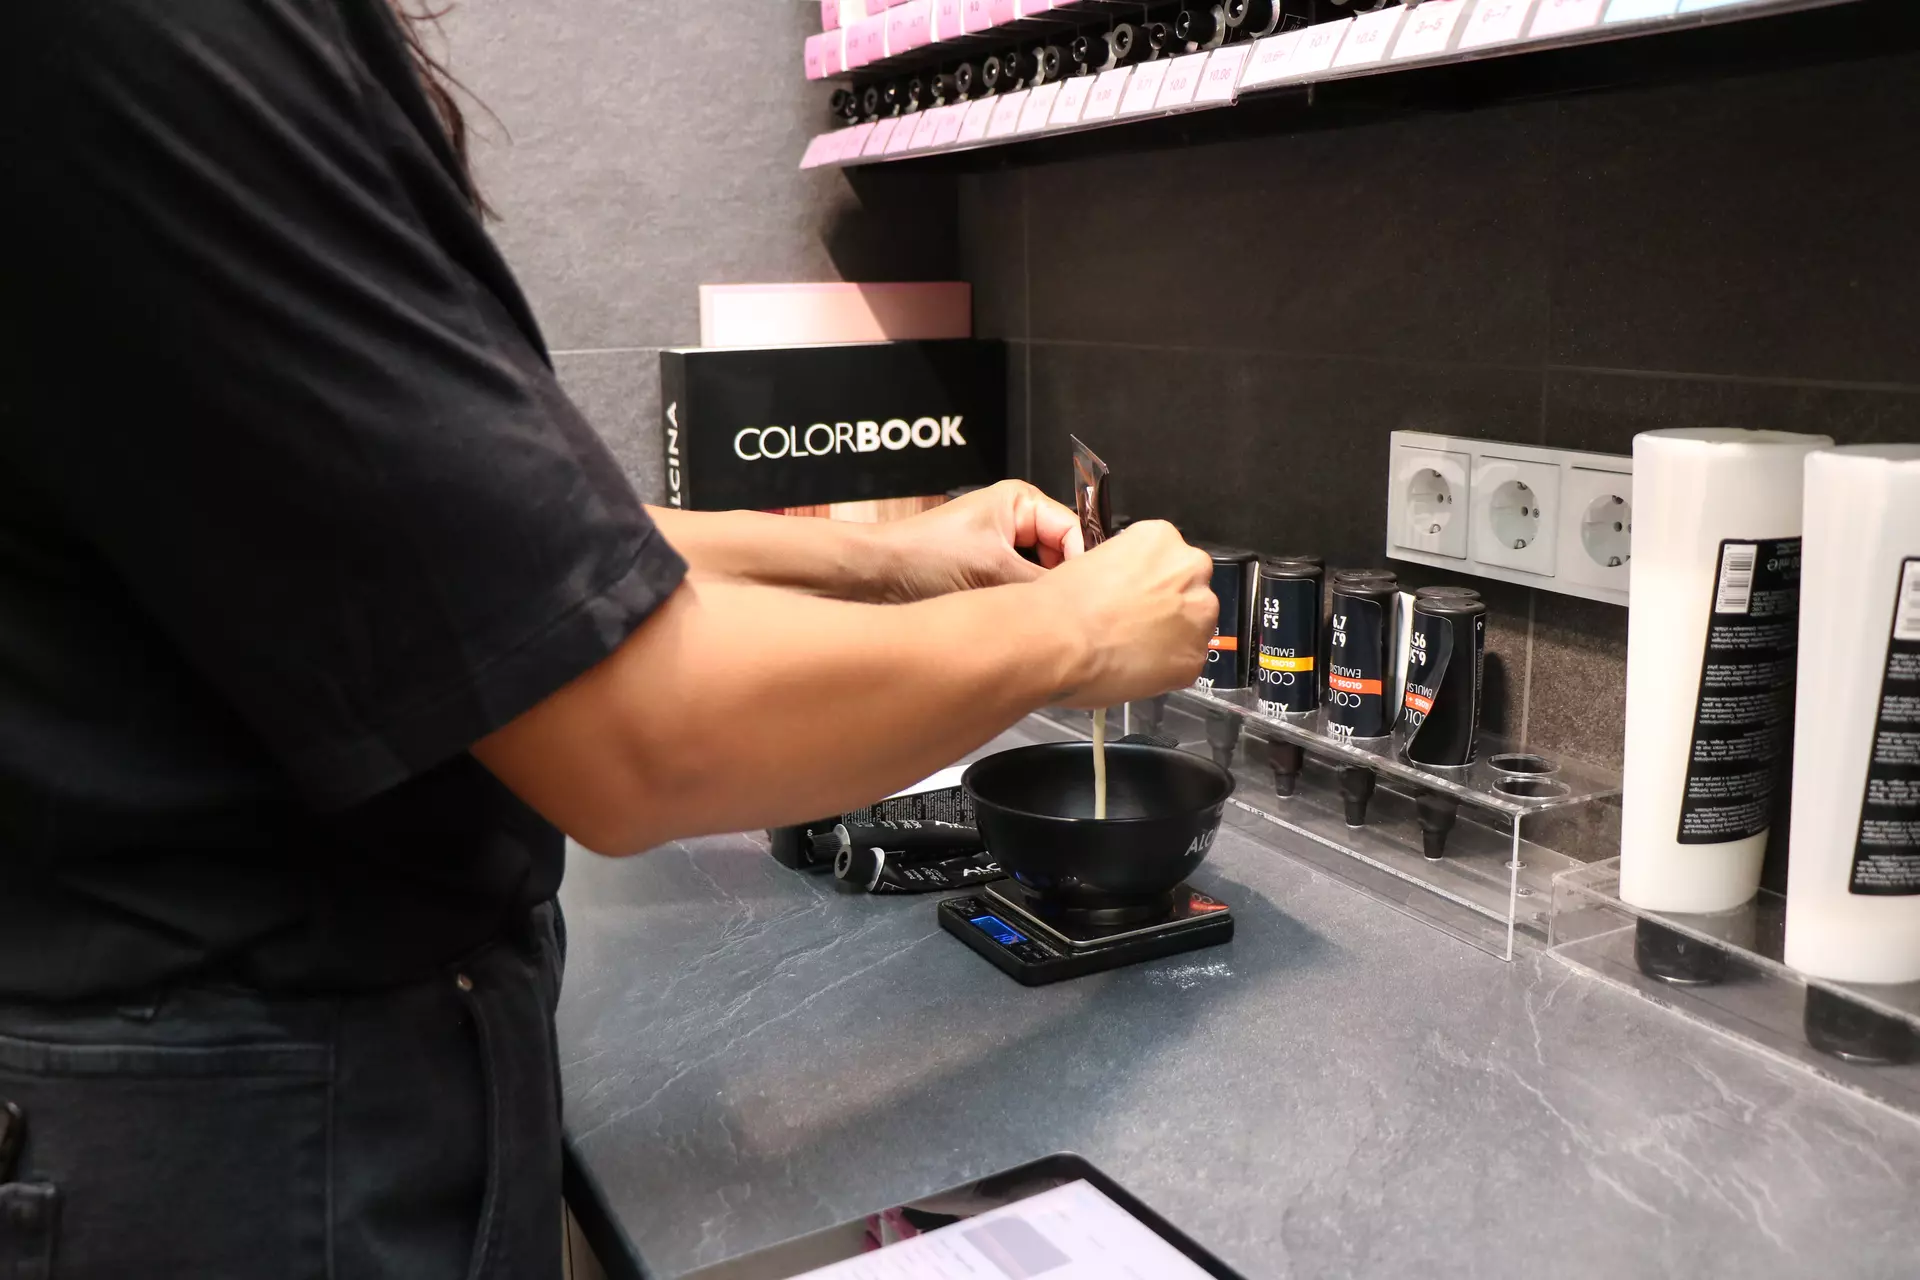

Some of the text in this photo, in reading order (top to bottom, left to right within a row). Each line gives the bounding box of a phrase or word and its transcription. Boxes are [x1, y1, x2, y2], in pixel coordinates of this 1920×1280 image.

[734, 415, 966, 461] COLORBOOK
[667, 402, 681, 509] LCINA
[1263, 597, 1280, 613] 5.3
[1263, 613, 1279, 629] 5.3
[1332, 613, 1347, 630] 6.7
[1332, 631, 1346, 648] 6.7
[1410, 631, 1427, 649] .56
[1338, 679, 1363, 690] GLOSS
[1184, 827, 1217, 856] ALC
